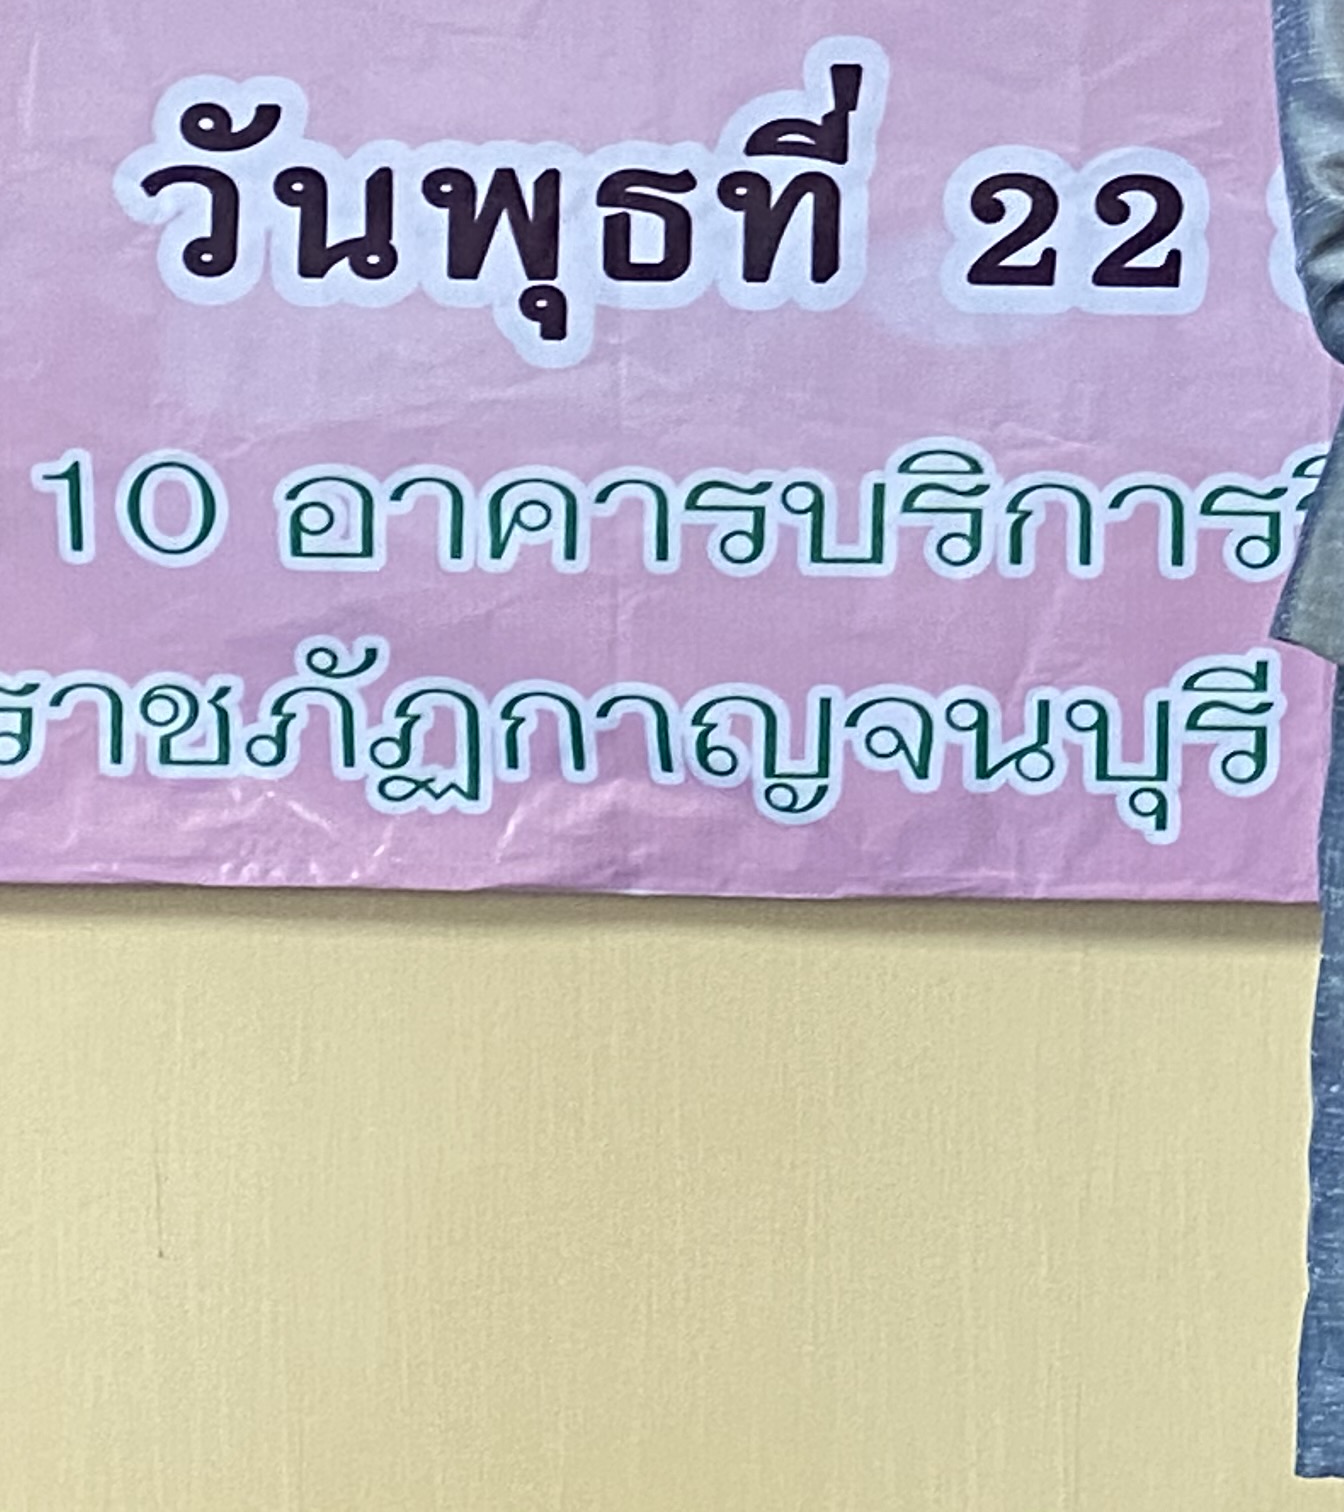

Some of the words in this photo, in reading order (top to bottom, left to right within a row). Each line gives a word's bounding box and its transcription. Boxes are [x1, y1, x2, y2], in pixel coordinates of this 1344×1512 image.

[141, 63, 863, 341] วันพุธที่
[967, 172, 1184, 288] 22
[43, 460, 217, 554] 10
